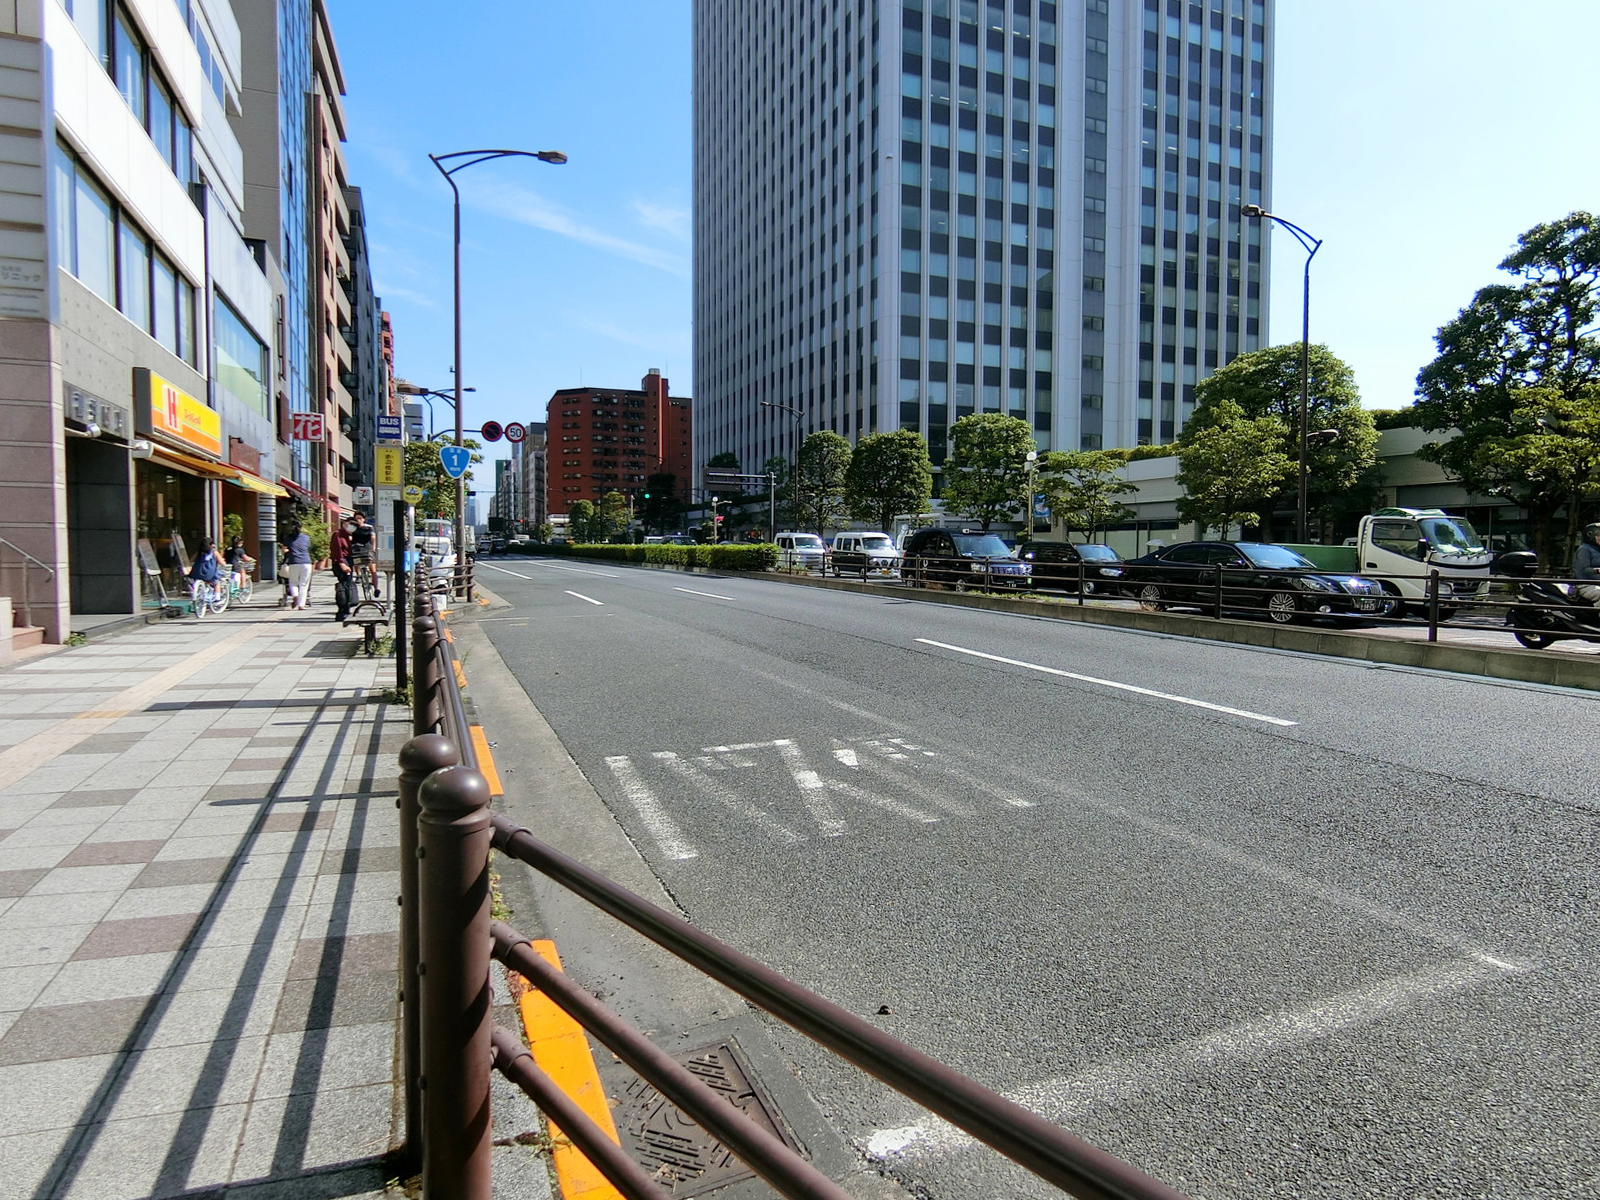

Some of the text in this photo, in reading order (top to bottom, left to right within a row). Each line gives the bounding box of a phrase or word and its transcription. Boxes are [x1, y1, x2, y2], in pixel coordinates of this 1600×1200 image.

[294, 414, 322, 440] 花
[379, 417, 399, 426] BUS
[510, 428, 522, 438] 50
[452, 454, 458, 466] 1
